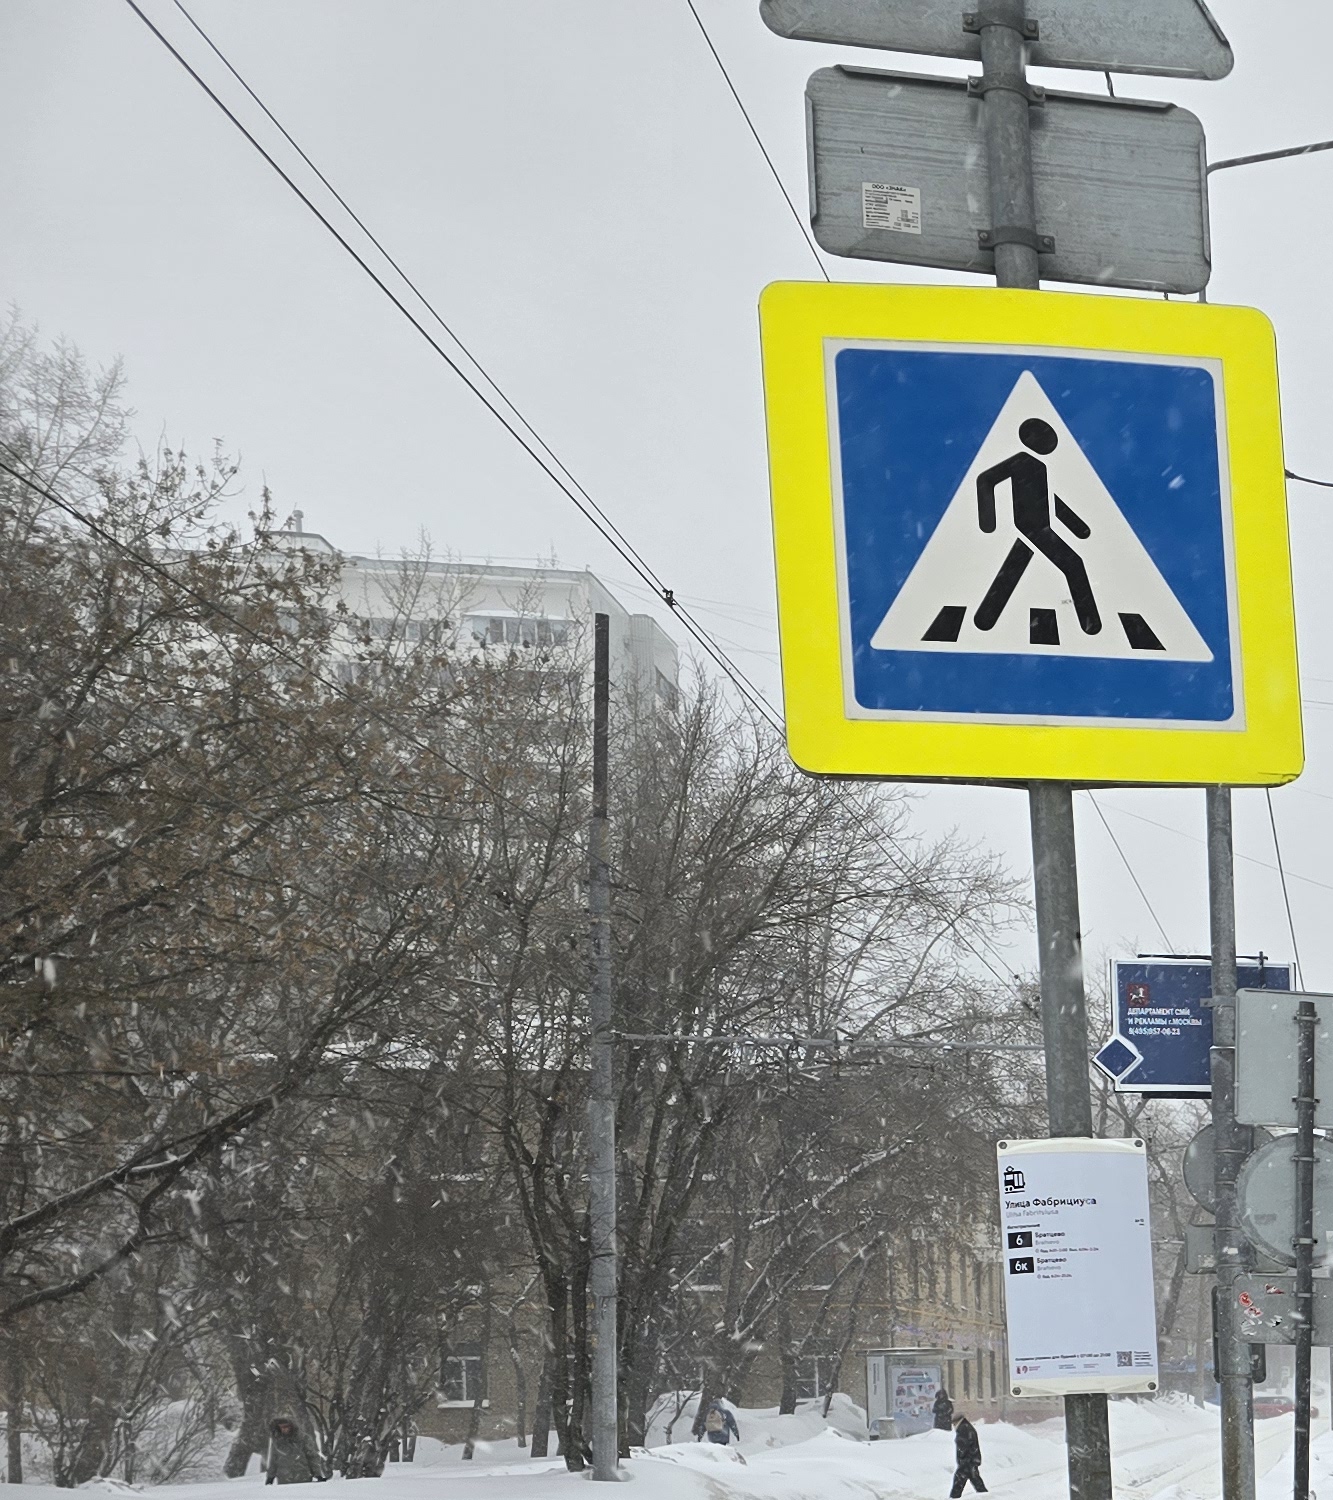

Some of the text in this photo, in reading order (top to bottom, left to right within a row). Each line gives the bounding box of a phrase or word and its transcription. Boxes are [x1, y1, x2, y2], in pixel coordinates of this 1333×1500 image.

[1127, 1007, 1173, 1016] ДЕПАРТАМЕНТ
[1005, 1197, 1096, 1209] Улица Фабрициуса
[1016, 1235, 1023, 1245] 6
[1015, 1261, 1028, 1271] 6к
